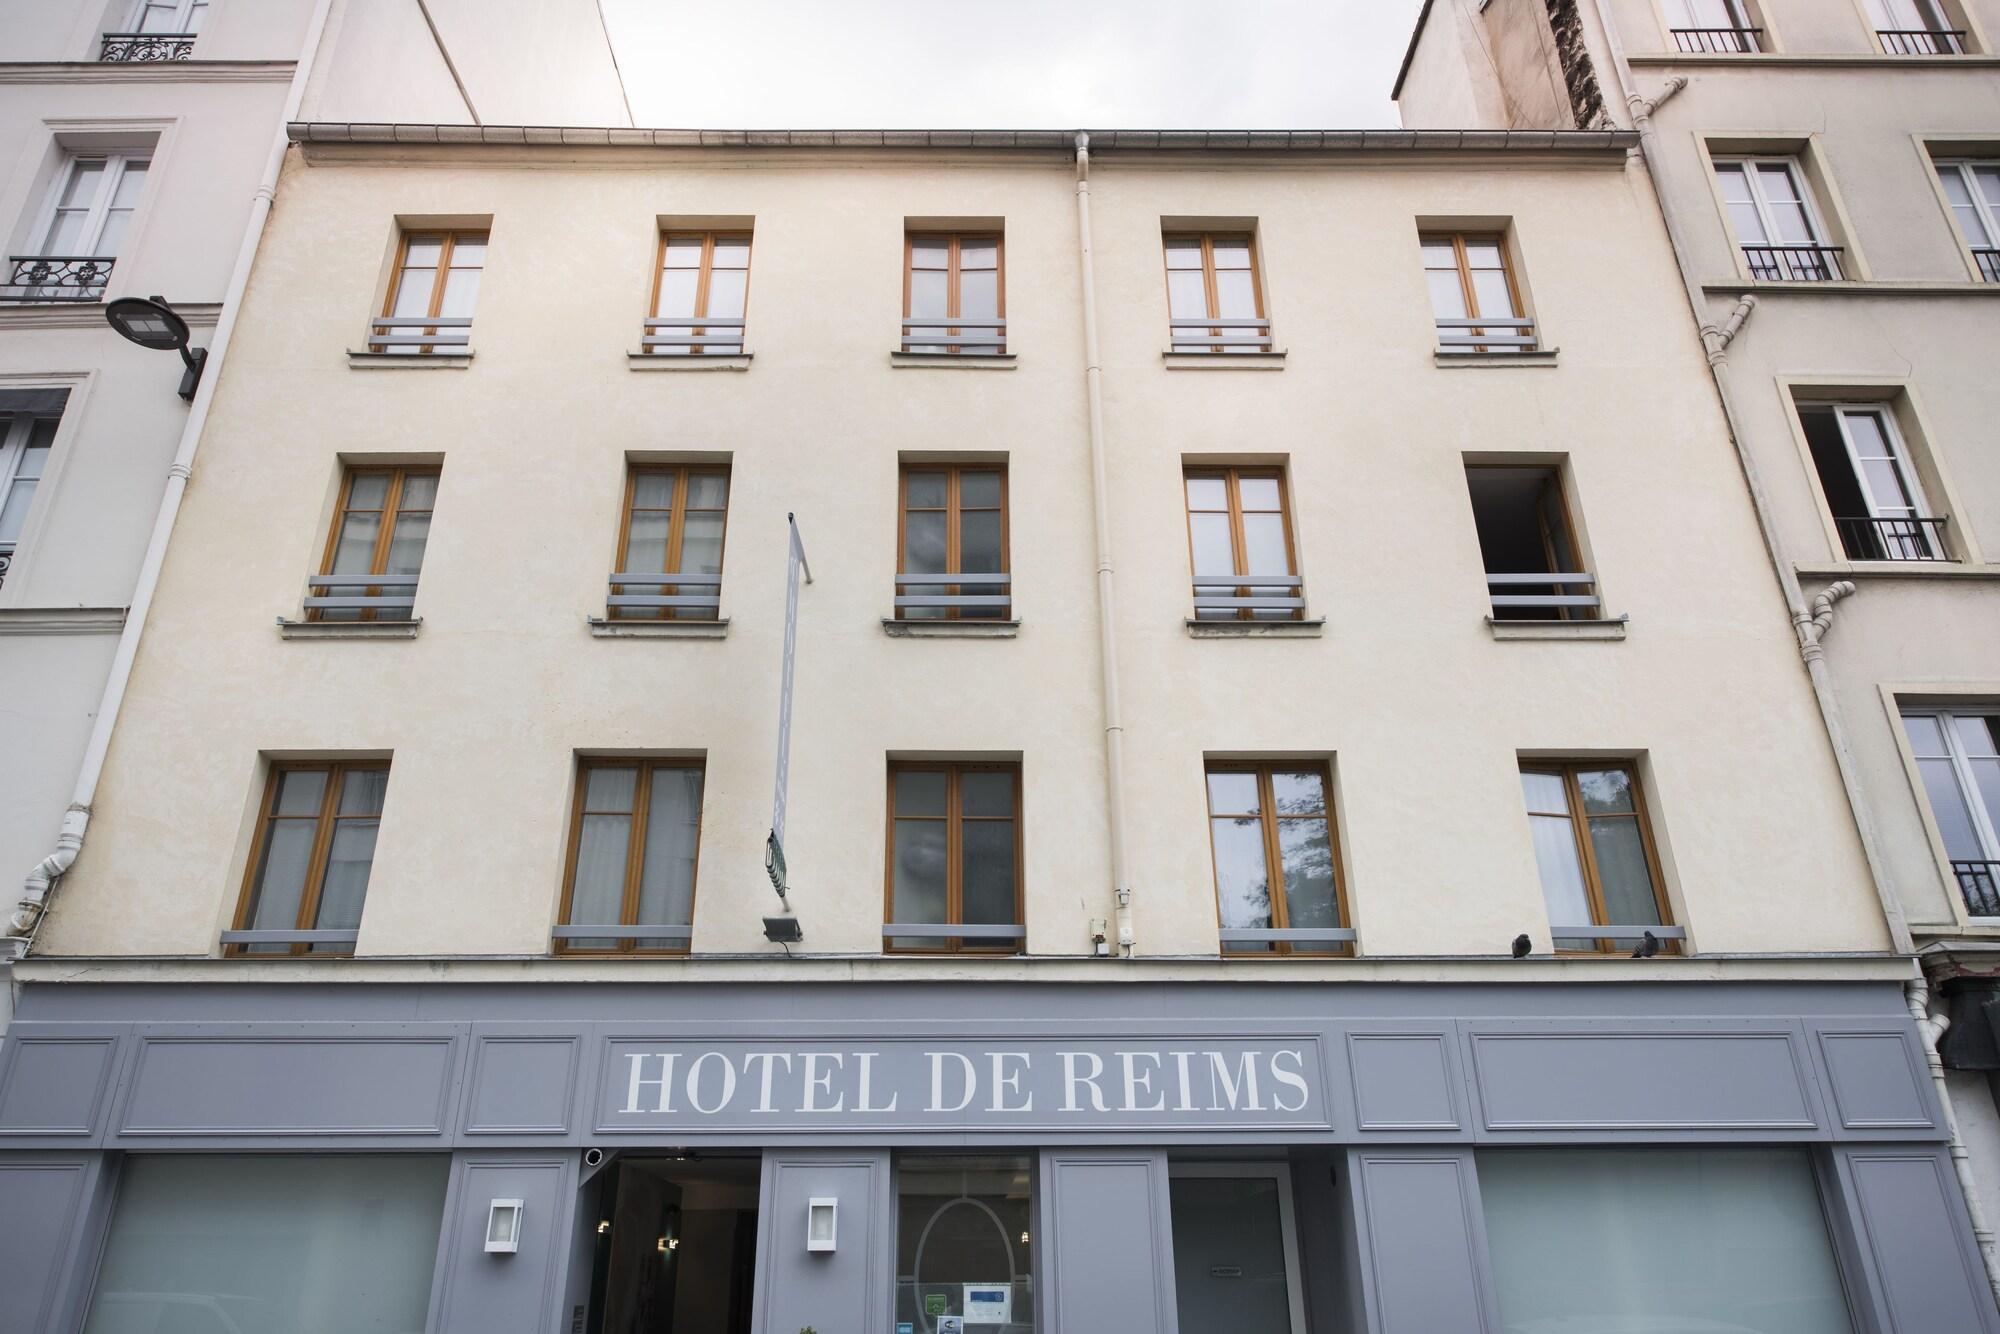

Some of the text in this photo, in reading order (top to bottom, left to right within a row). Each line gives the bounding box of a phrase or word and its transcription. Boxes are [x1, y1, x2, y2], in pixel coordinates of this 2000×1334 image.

[618, 1050, 1309, 1114] HOTEL DE REIMS
